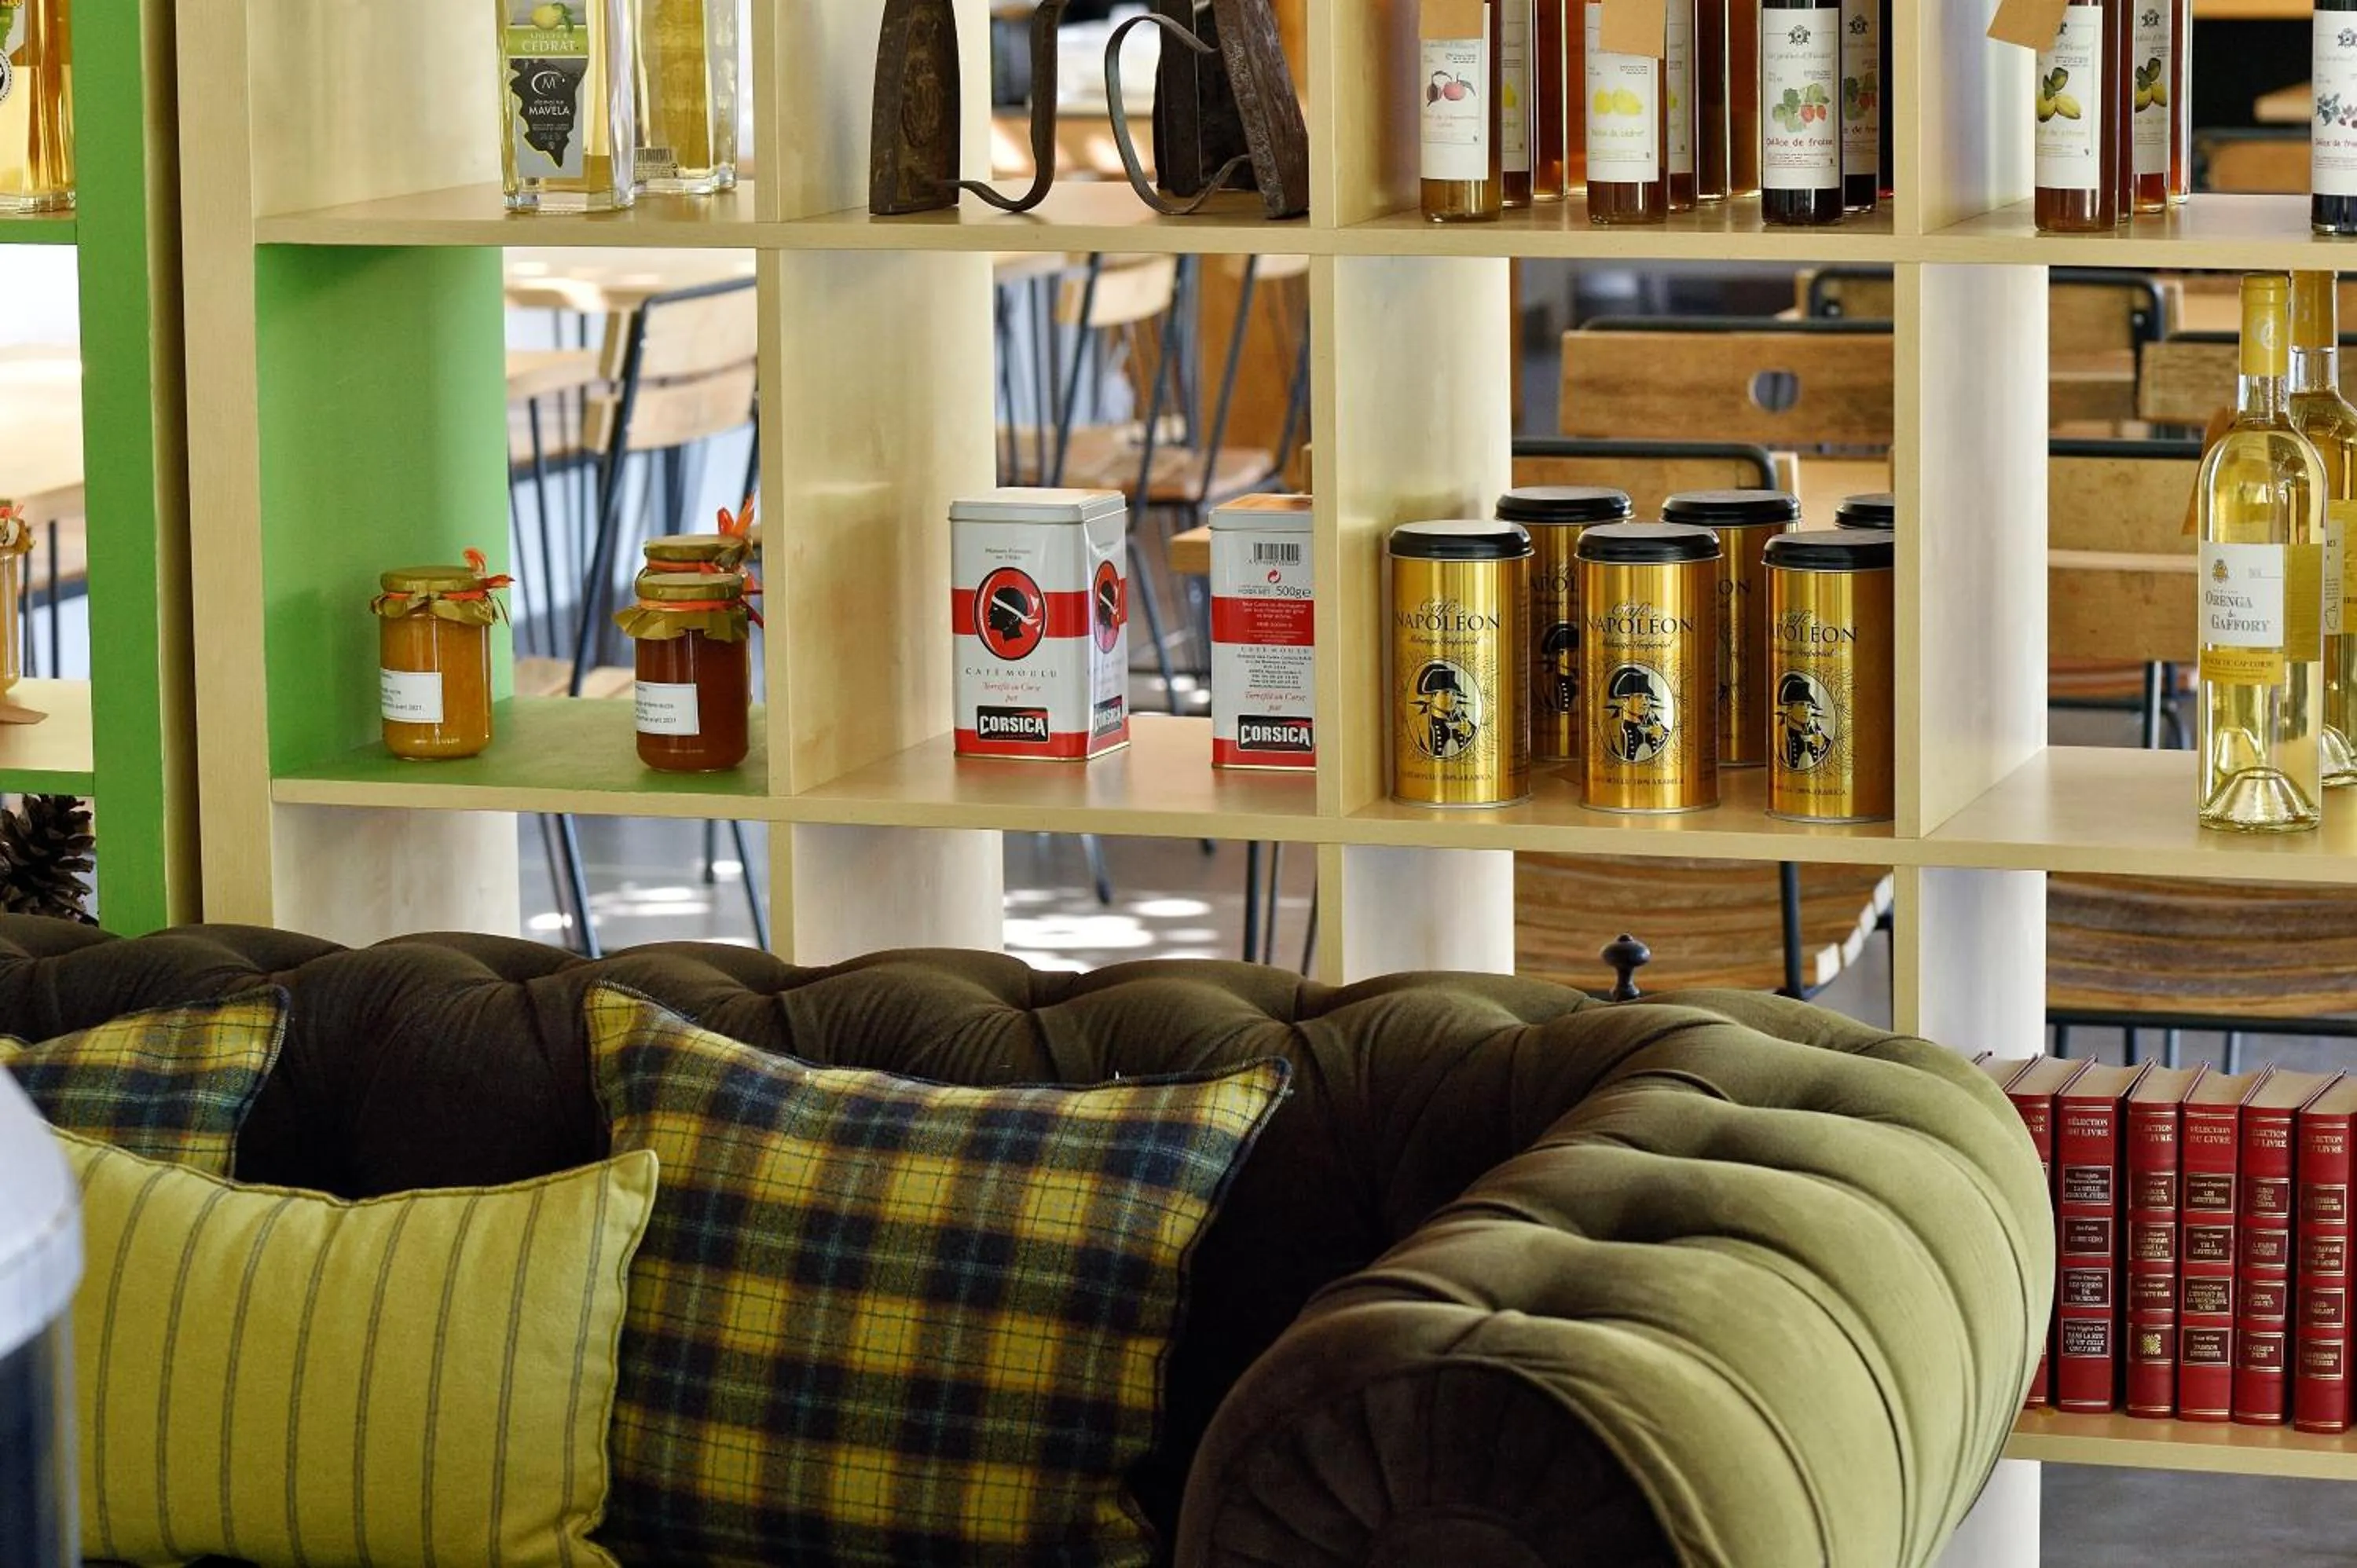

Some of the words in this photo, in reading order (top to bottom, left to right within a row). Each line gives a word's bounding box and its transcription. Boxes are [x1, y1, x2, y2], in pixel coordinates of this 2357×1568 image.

[529, 106, 570, 115] MAVELA
[1792, 138, 1803, 147] de
[1396, 610, 1501, 632] NAPOLÉON
[1584, 614, 1696, 635] NAPOLÉON
[980, 716, 1046, 737] CORSICA
[1241, 724, 1311, 747] CORSICA
[2081, 1128, 2110, 1138] LIVRE
[2203, 1135, 2231, 1145] LIVRE
[2262, 1139, 2287, 1148] LIVRE
